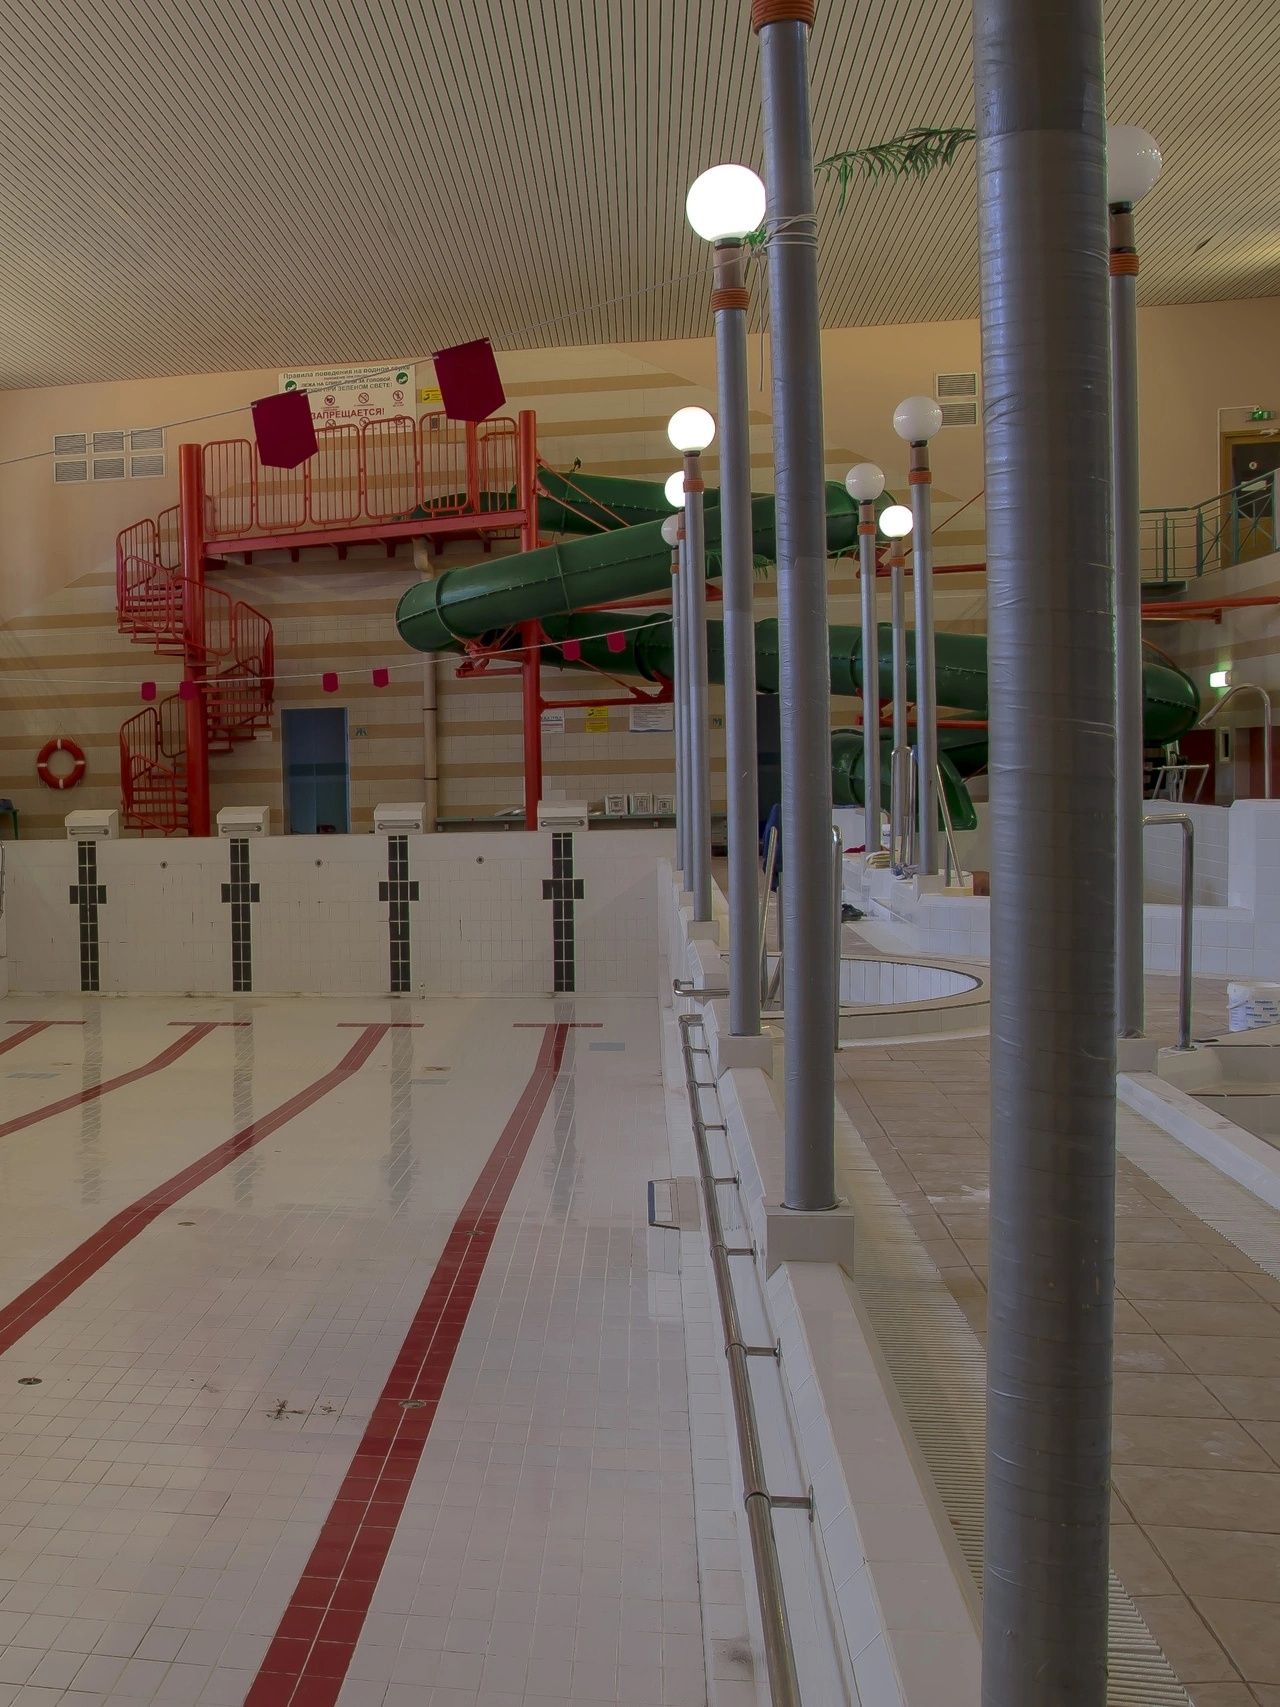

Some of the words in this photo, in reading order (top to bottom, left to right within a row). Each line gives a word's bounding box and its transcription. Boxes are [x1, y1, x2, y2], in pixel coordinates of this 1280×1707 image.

[283, 372, 313, 380] Правила
[315, 370, 352, 378] поведения
[311, 407, 385, 420] ЗАПРЕЩАЕТСЯ!
